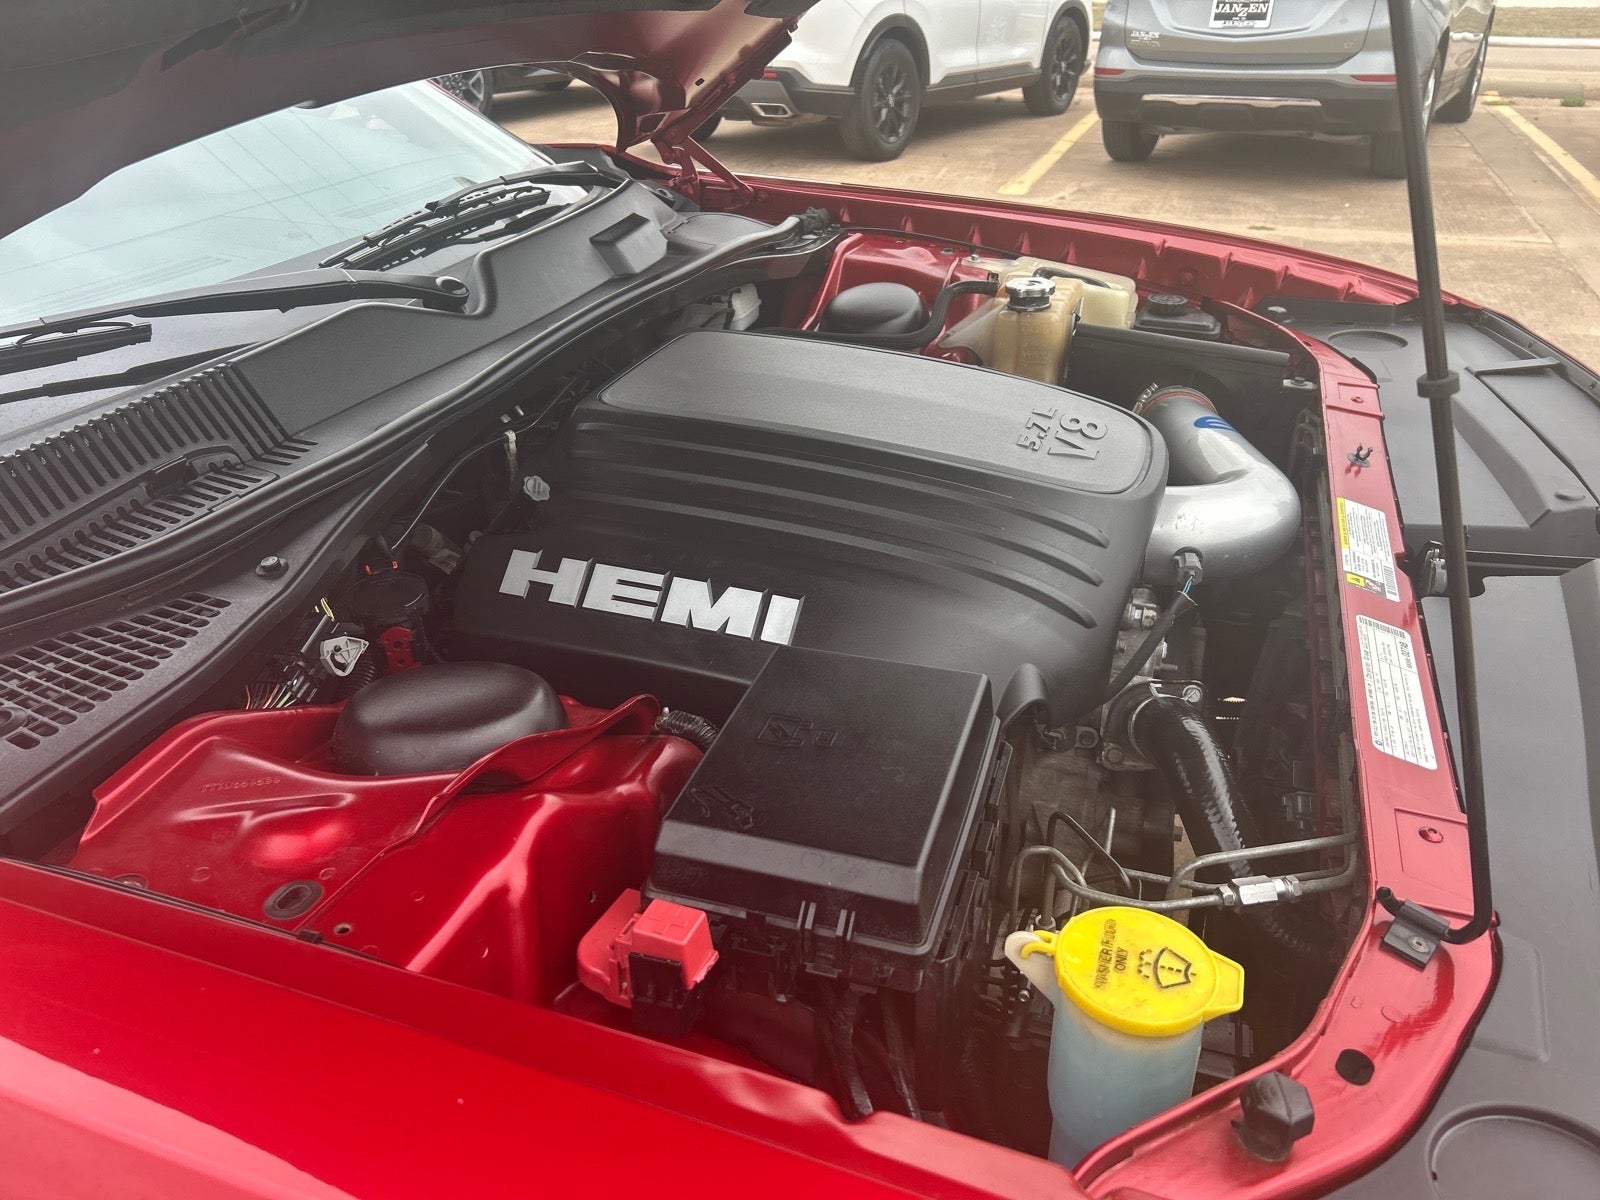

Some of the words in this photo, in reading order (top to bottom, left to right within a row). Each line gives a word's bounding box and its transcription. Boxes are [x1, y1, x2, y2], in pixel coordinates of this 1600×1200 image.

[1215, 3, 1269, 17] JANZEN
[1016, 408, 1057, 451] 5.7L
[1047, 413, 1108, 460] V8
[498, 549, 805, 646] HEMI
[1095, 947, 1112, 988] WASHER
[1114, 947, 1128, 971] ONLY
